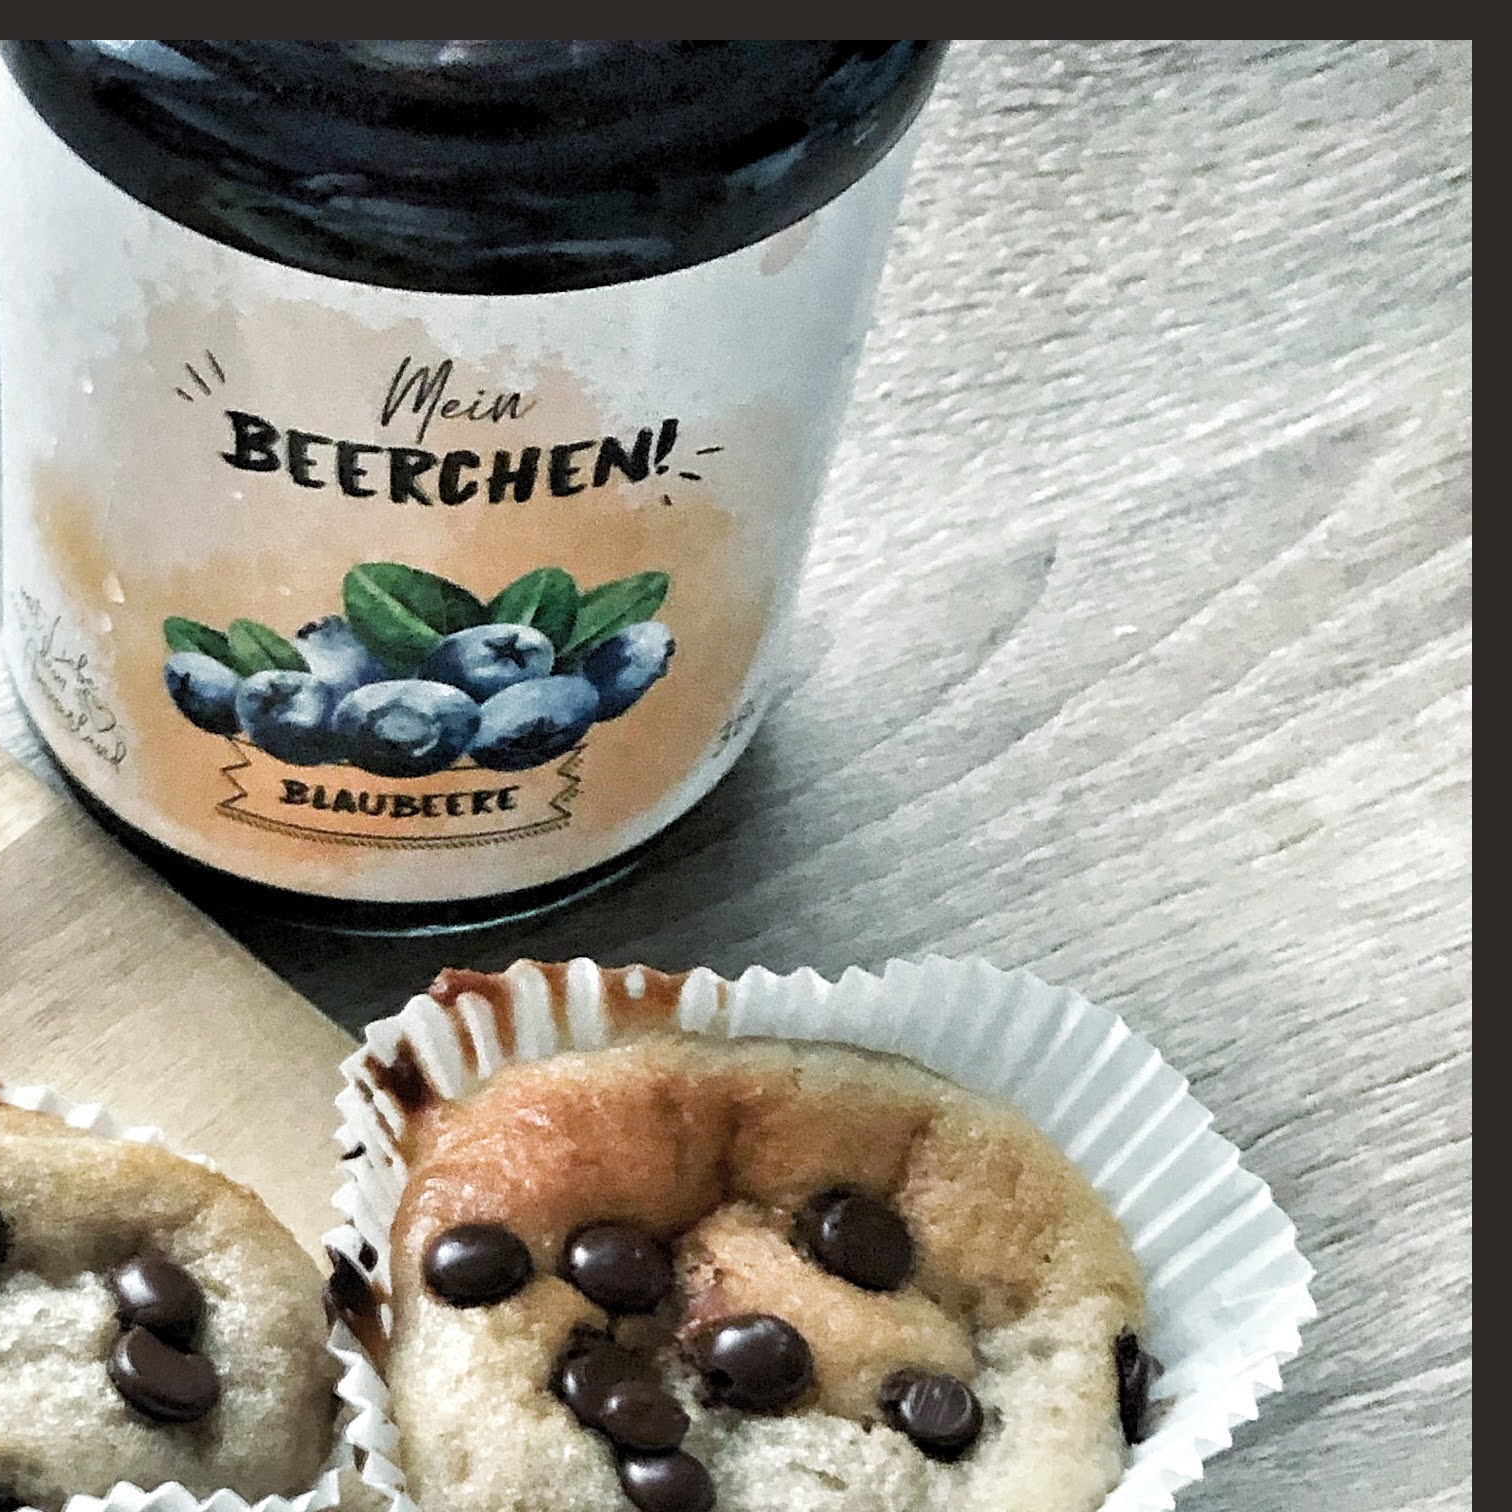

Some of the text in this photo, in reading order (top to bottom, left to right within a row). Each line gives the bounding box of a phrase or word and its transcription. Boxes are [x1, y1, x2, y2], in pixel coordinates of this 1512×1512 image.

[380, 355, 532, 443] Mein
[221, 410, 679, 506] BEERCHEN!
[279, 778, 521, 819] BLAUBEERE
